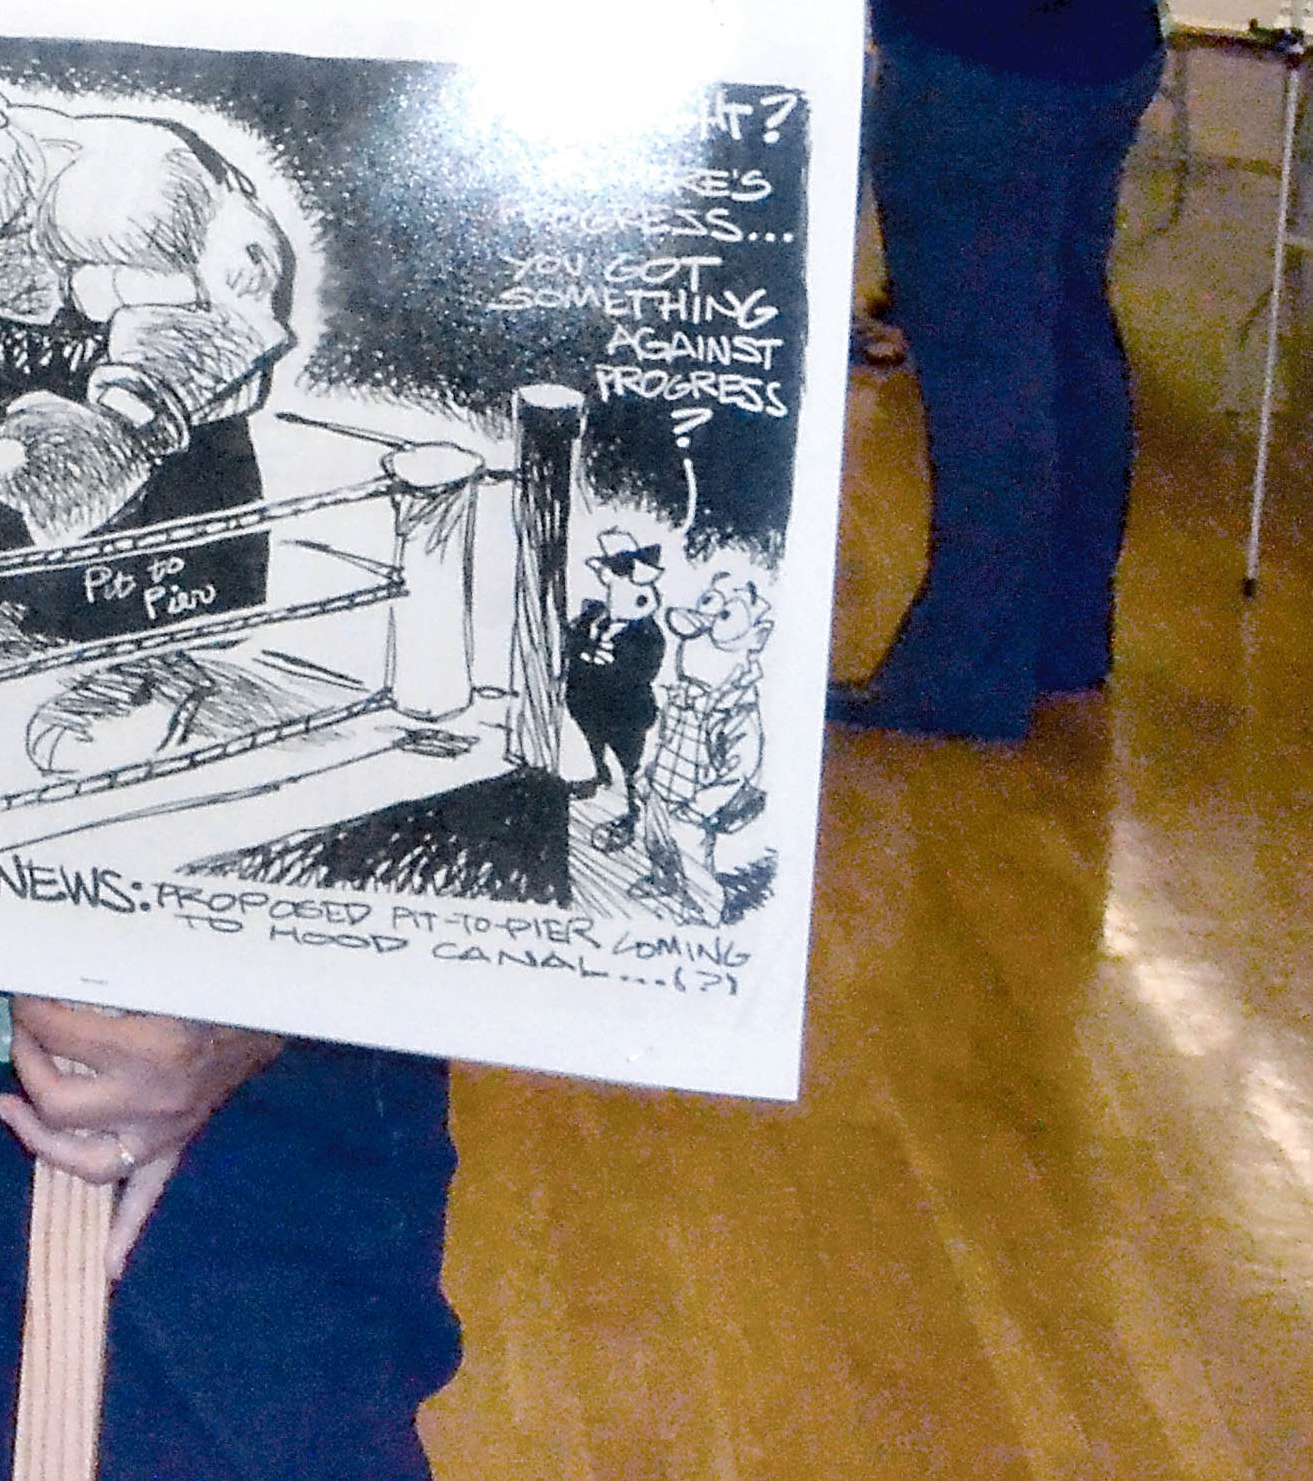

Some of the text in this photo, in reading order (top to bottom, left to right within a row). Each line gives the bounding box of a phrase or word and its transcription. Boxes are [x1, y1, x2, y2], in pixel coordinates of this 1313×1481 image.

[501, 252, 724, 293] YOU GOT
[487, 285, 779, 330] SOMETHING
[607, 322, 784, 370] AGAINST
[595, 364, 788, 417] PROGRESS
[154, 881, 373, 926] PROPOSED
[392, 905, 602, 949] PIT-TO-PIER
[612, 930, 752, 967] COMING
[174, 914, 243, 934] TO
[268, 923, 410, 954] HOOD
